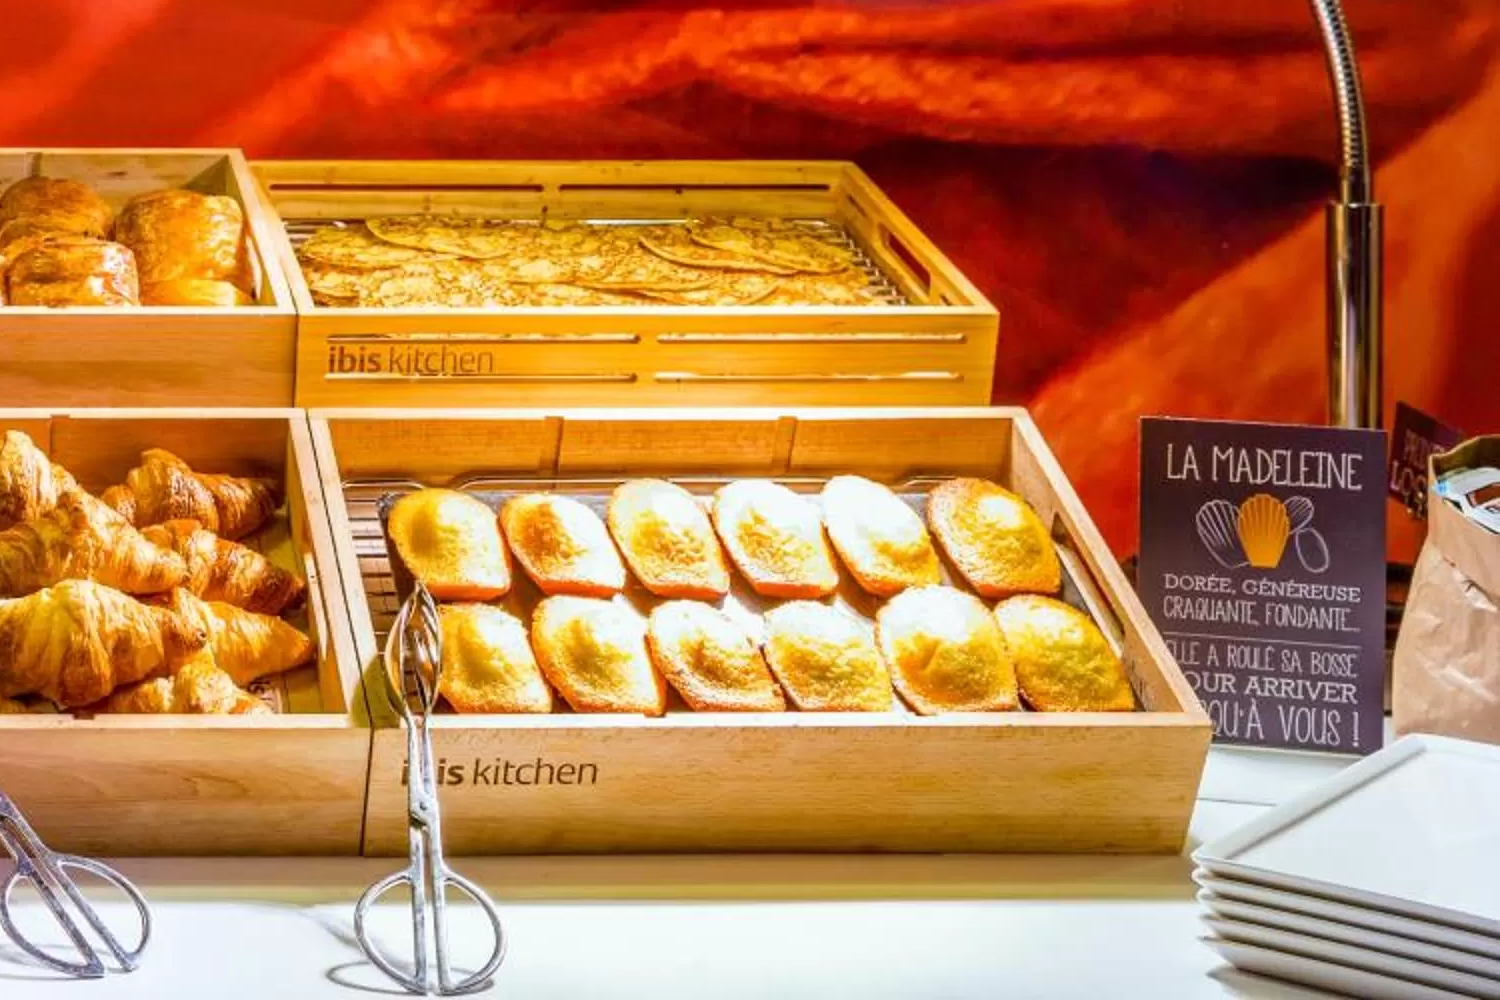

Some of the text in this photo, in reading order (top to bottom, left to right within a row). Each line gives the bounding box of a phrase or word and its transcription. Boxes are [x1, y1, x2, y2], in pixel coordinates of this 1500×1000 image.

[328, 345, 494, 375] ibis kitchen
[1167, 443, 1200, 481] LA
[1212, 445, 1362, 491] MADELEINE
[1163, 573, 1361, 603] DORÉE, GÉNÉREUSE
[1207, 643, 1220, 668] A
[1281, 649, 1303, 674] SA
[1311, 651, 1359, 678] BOSSE
[1183, 671, 1359, 704] OUR ARRIVER
[1277, 704, 1342, 746] VOUS
[401, 757, 598, 786] iis kitchen
